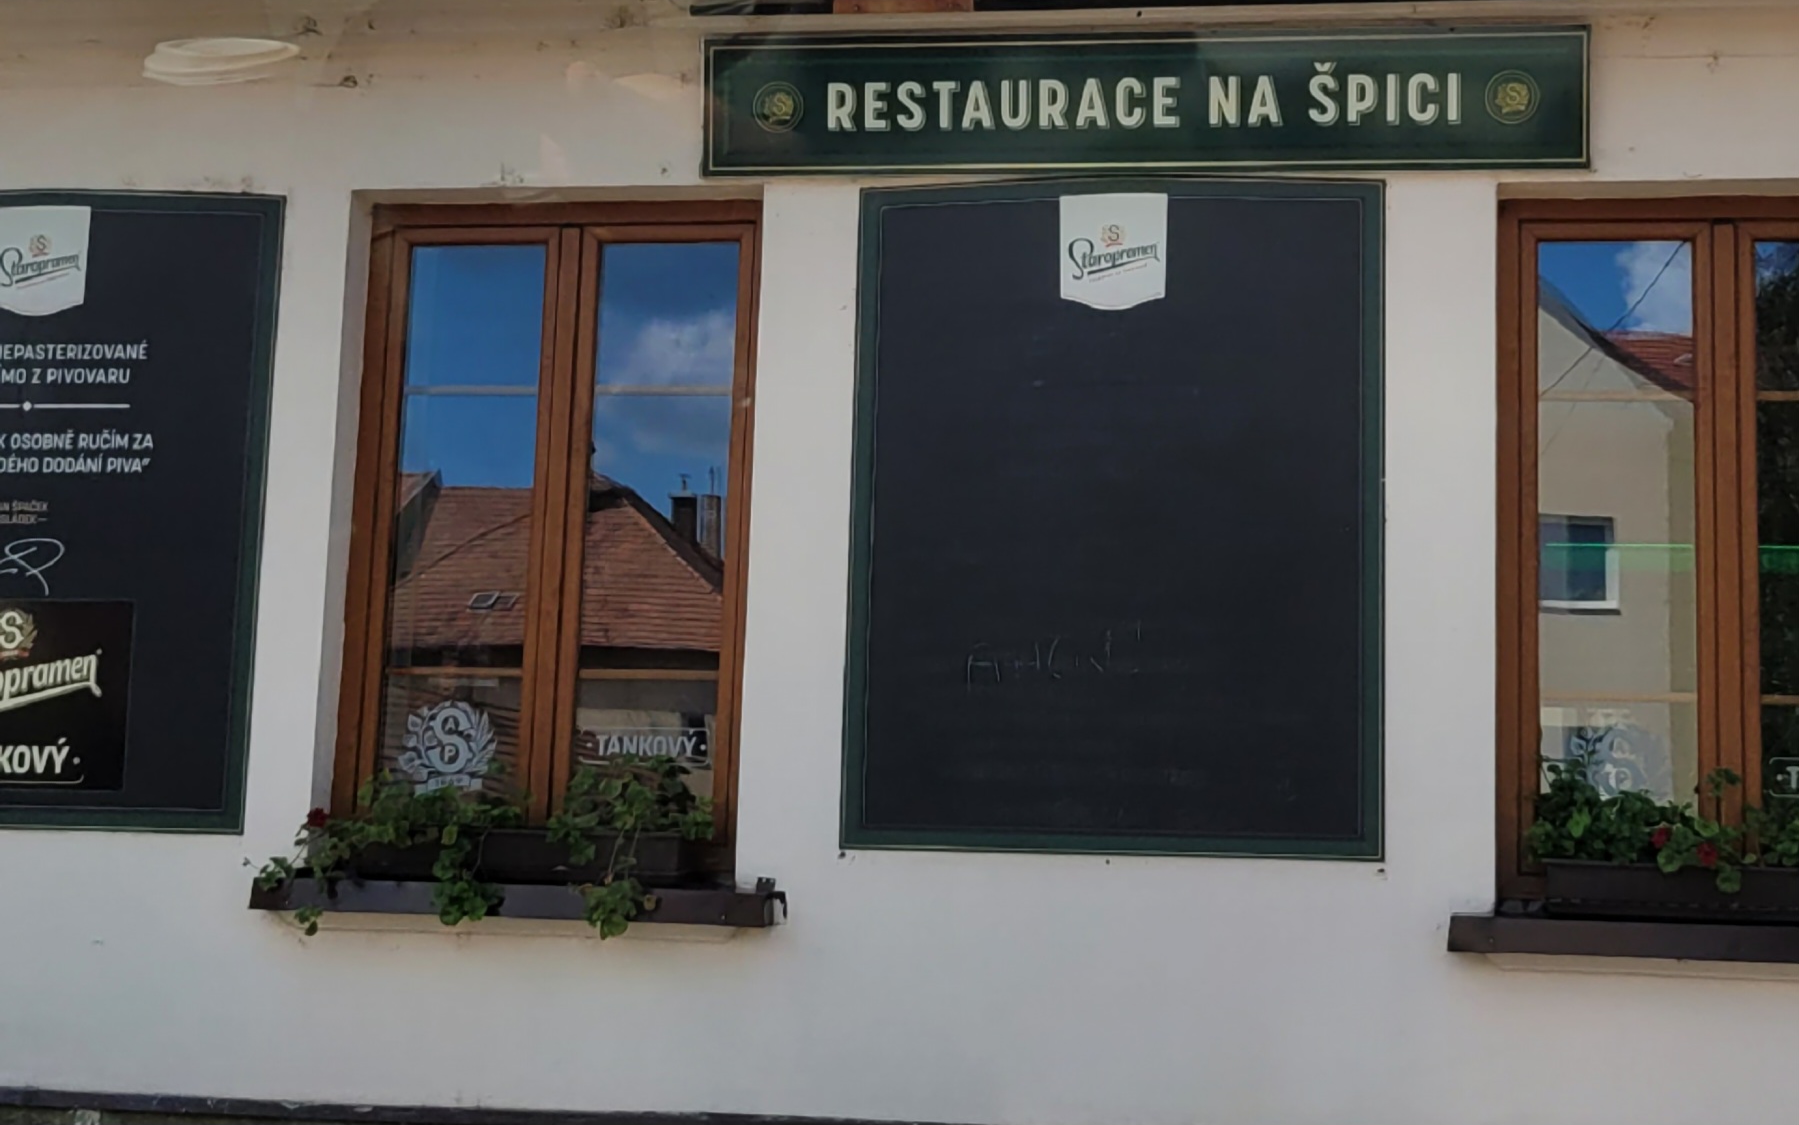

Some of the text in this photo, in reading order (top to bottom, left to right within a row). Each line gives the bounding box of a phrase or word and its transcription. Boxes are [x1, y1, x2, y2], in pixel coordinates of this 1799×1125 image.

[827, 61, 1462, 131] RESTAURACE NA ŠPICI
[0, 247, 82, 287] Staropramen
[1068, 237, 1160, 280] Staropramen
[0, 339, 149, 360] EPASTERIZOVANÉ
[31, 368, 42, 384] Z
[46, 367, 131, 384] PIVOVARU
[10, 429, 75, 450] OSOBNĚ
[77, 429, 130, 450] RUČÍM
[132, 433, 154, 450] ZA
[42, 452, 103, 473] DODÁNÍ
[596, 729, 697, 757] TANKOVÝ
